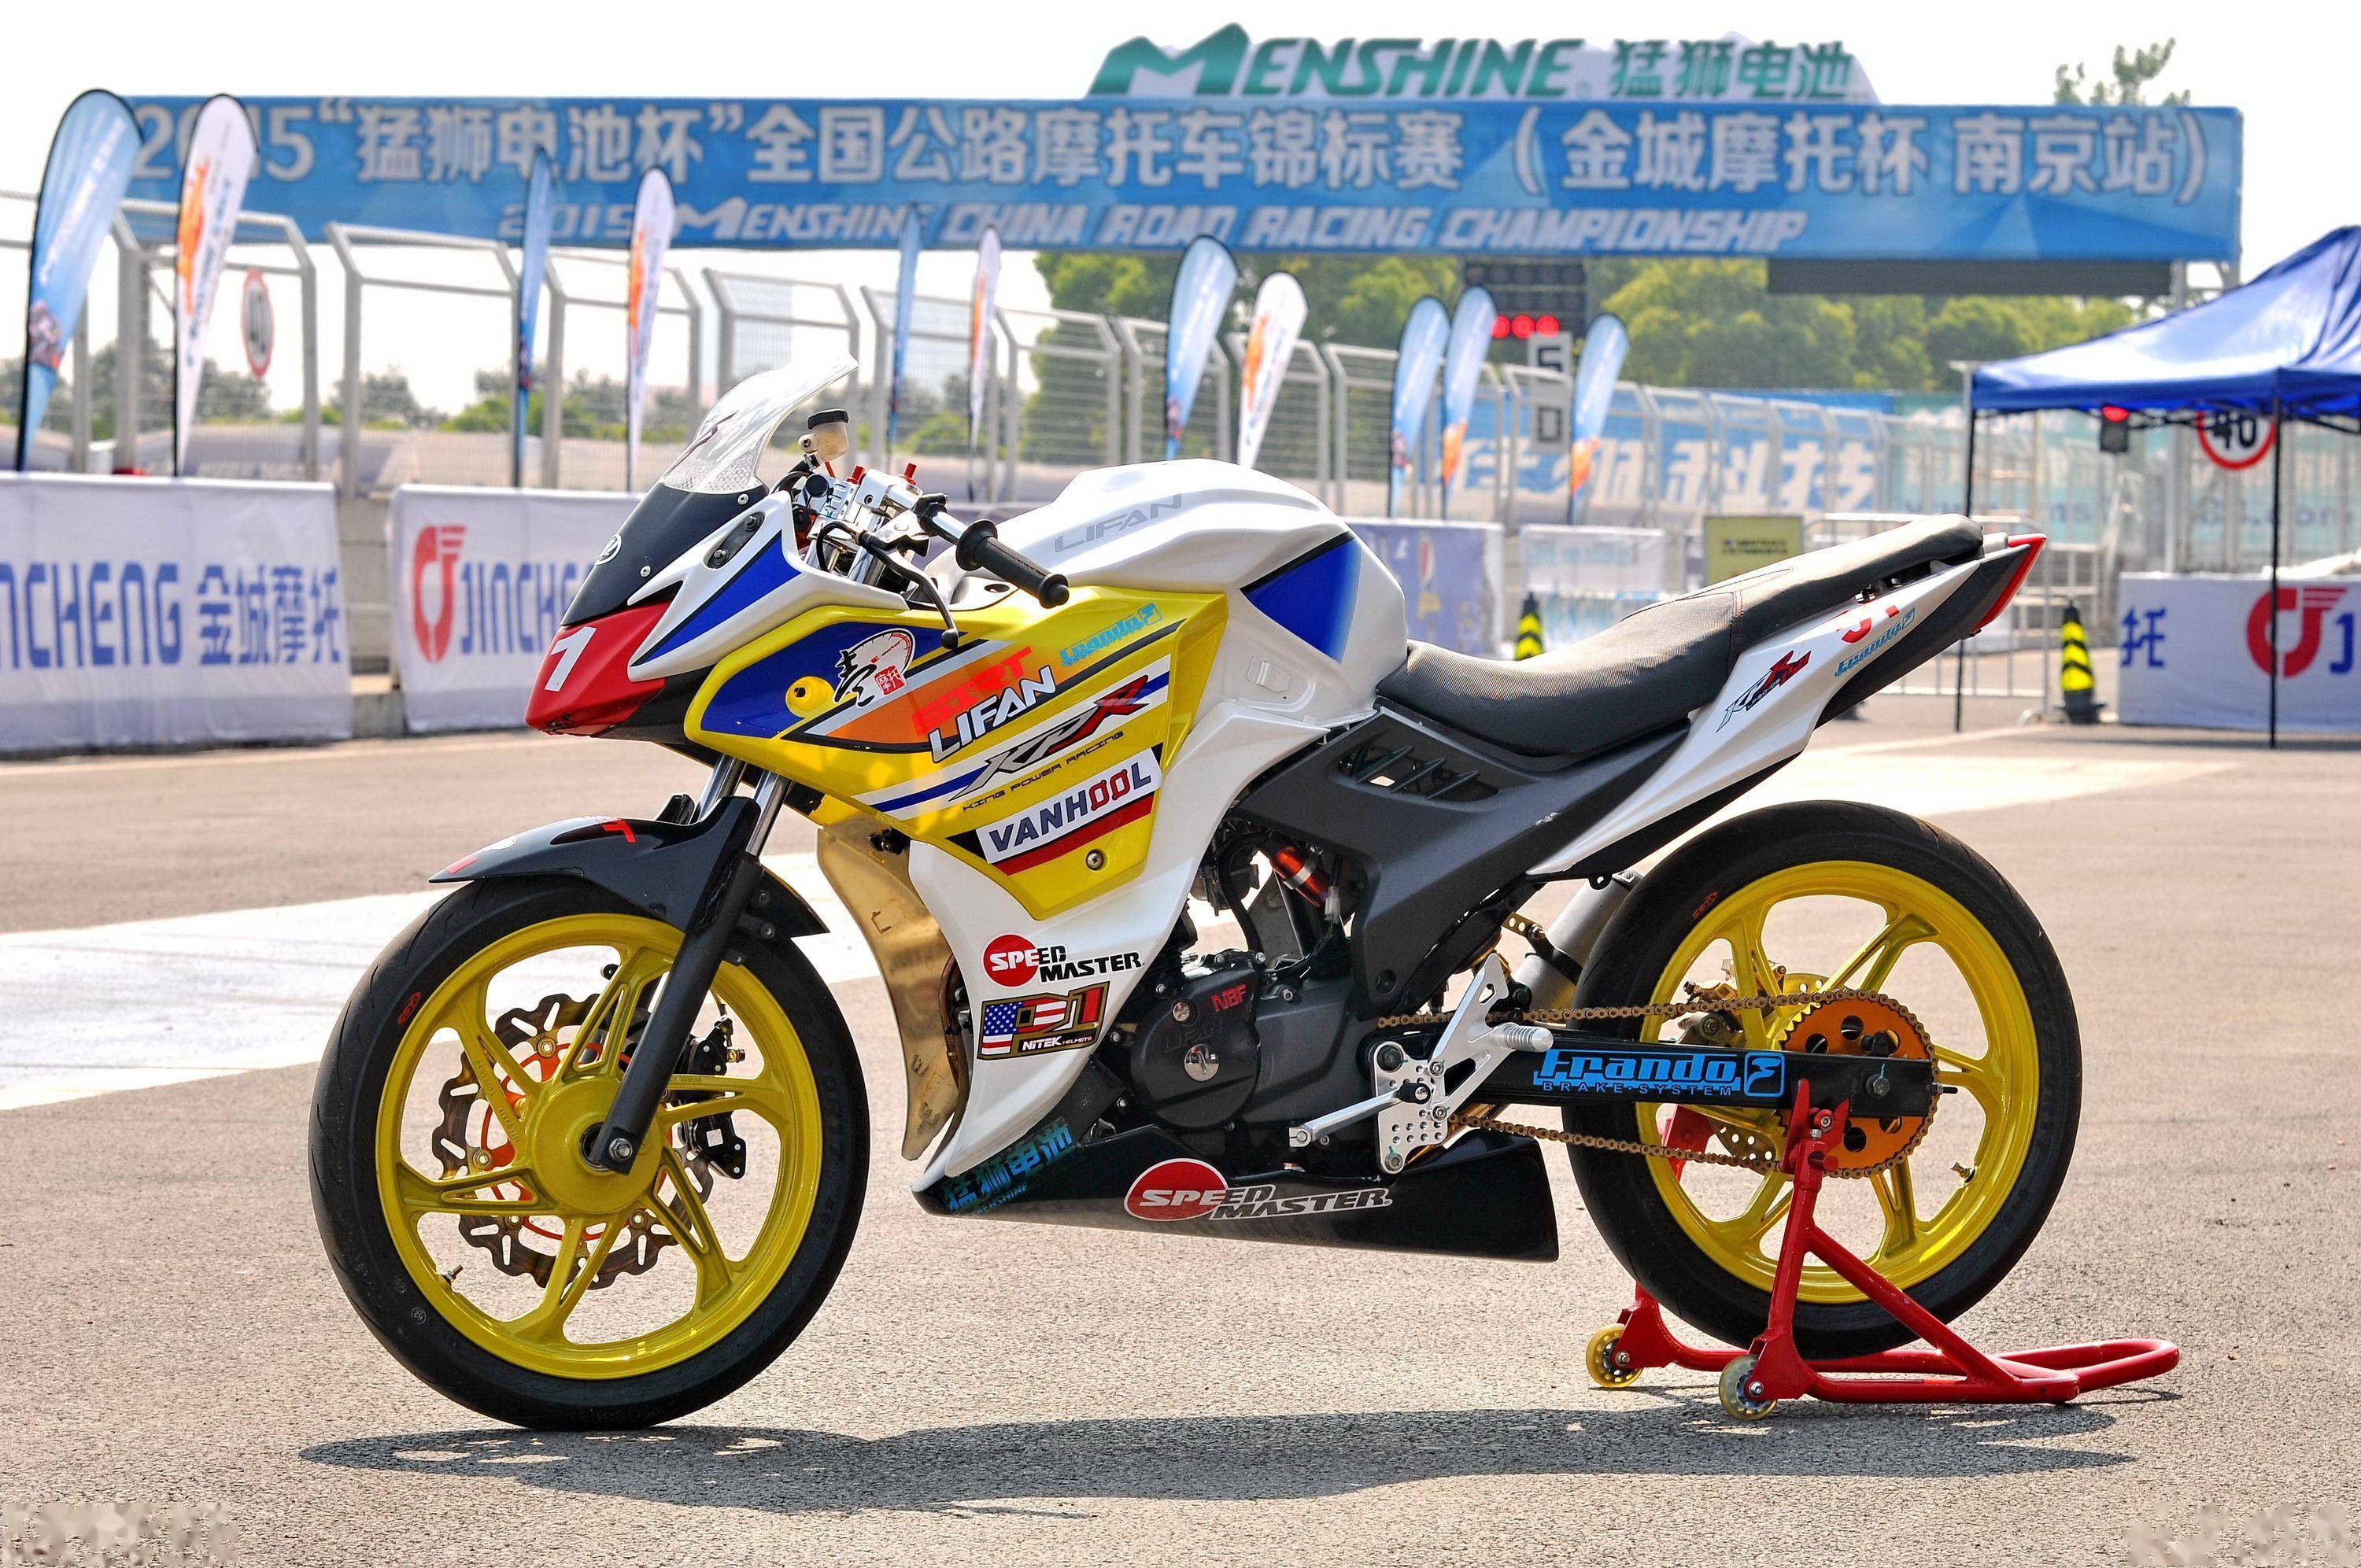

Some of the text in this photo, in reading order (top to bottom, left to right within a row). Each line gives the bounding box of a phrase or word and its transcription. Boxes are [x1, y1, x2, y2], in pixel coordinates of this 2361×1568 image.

[1088, 22, 1583, 98] MENSHINE
[1612, 39, 1853, 100] 猛狮电池
[943, 203, 1091, 245] CHINA
[1098, 205, 1237, 247] ROAD
[1243, 206, 1431, 249] RACING
[1437, 208, 1809, 252] CHAMPIONSHIP
[1055, 493, 1182, 553] LIFAN
[196, 563, 342, 666] 金城摩托
[928, 664, 1058, 765] LIFAN
[963, 729, 1125, 812] KING POWER RACING
[988, 761, 1152, 854] VANHOOL
[991, 944, 1066, 972] SPEED
[1040, 951, 1144, 983] MASTER
[1210, 983, 1247, 1013] NBF
[1140, 1186, 1273, 1206] SPEED
[1216, 1190, 1392, 1219] MASTER
